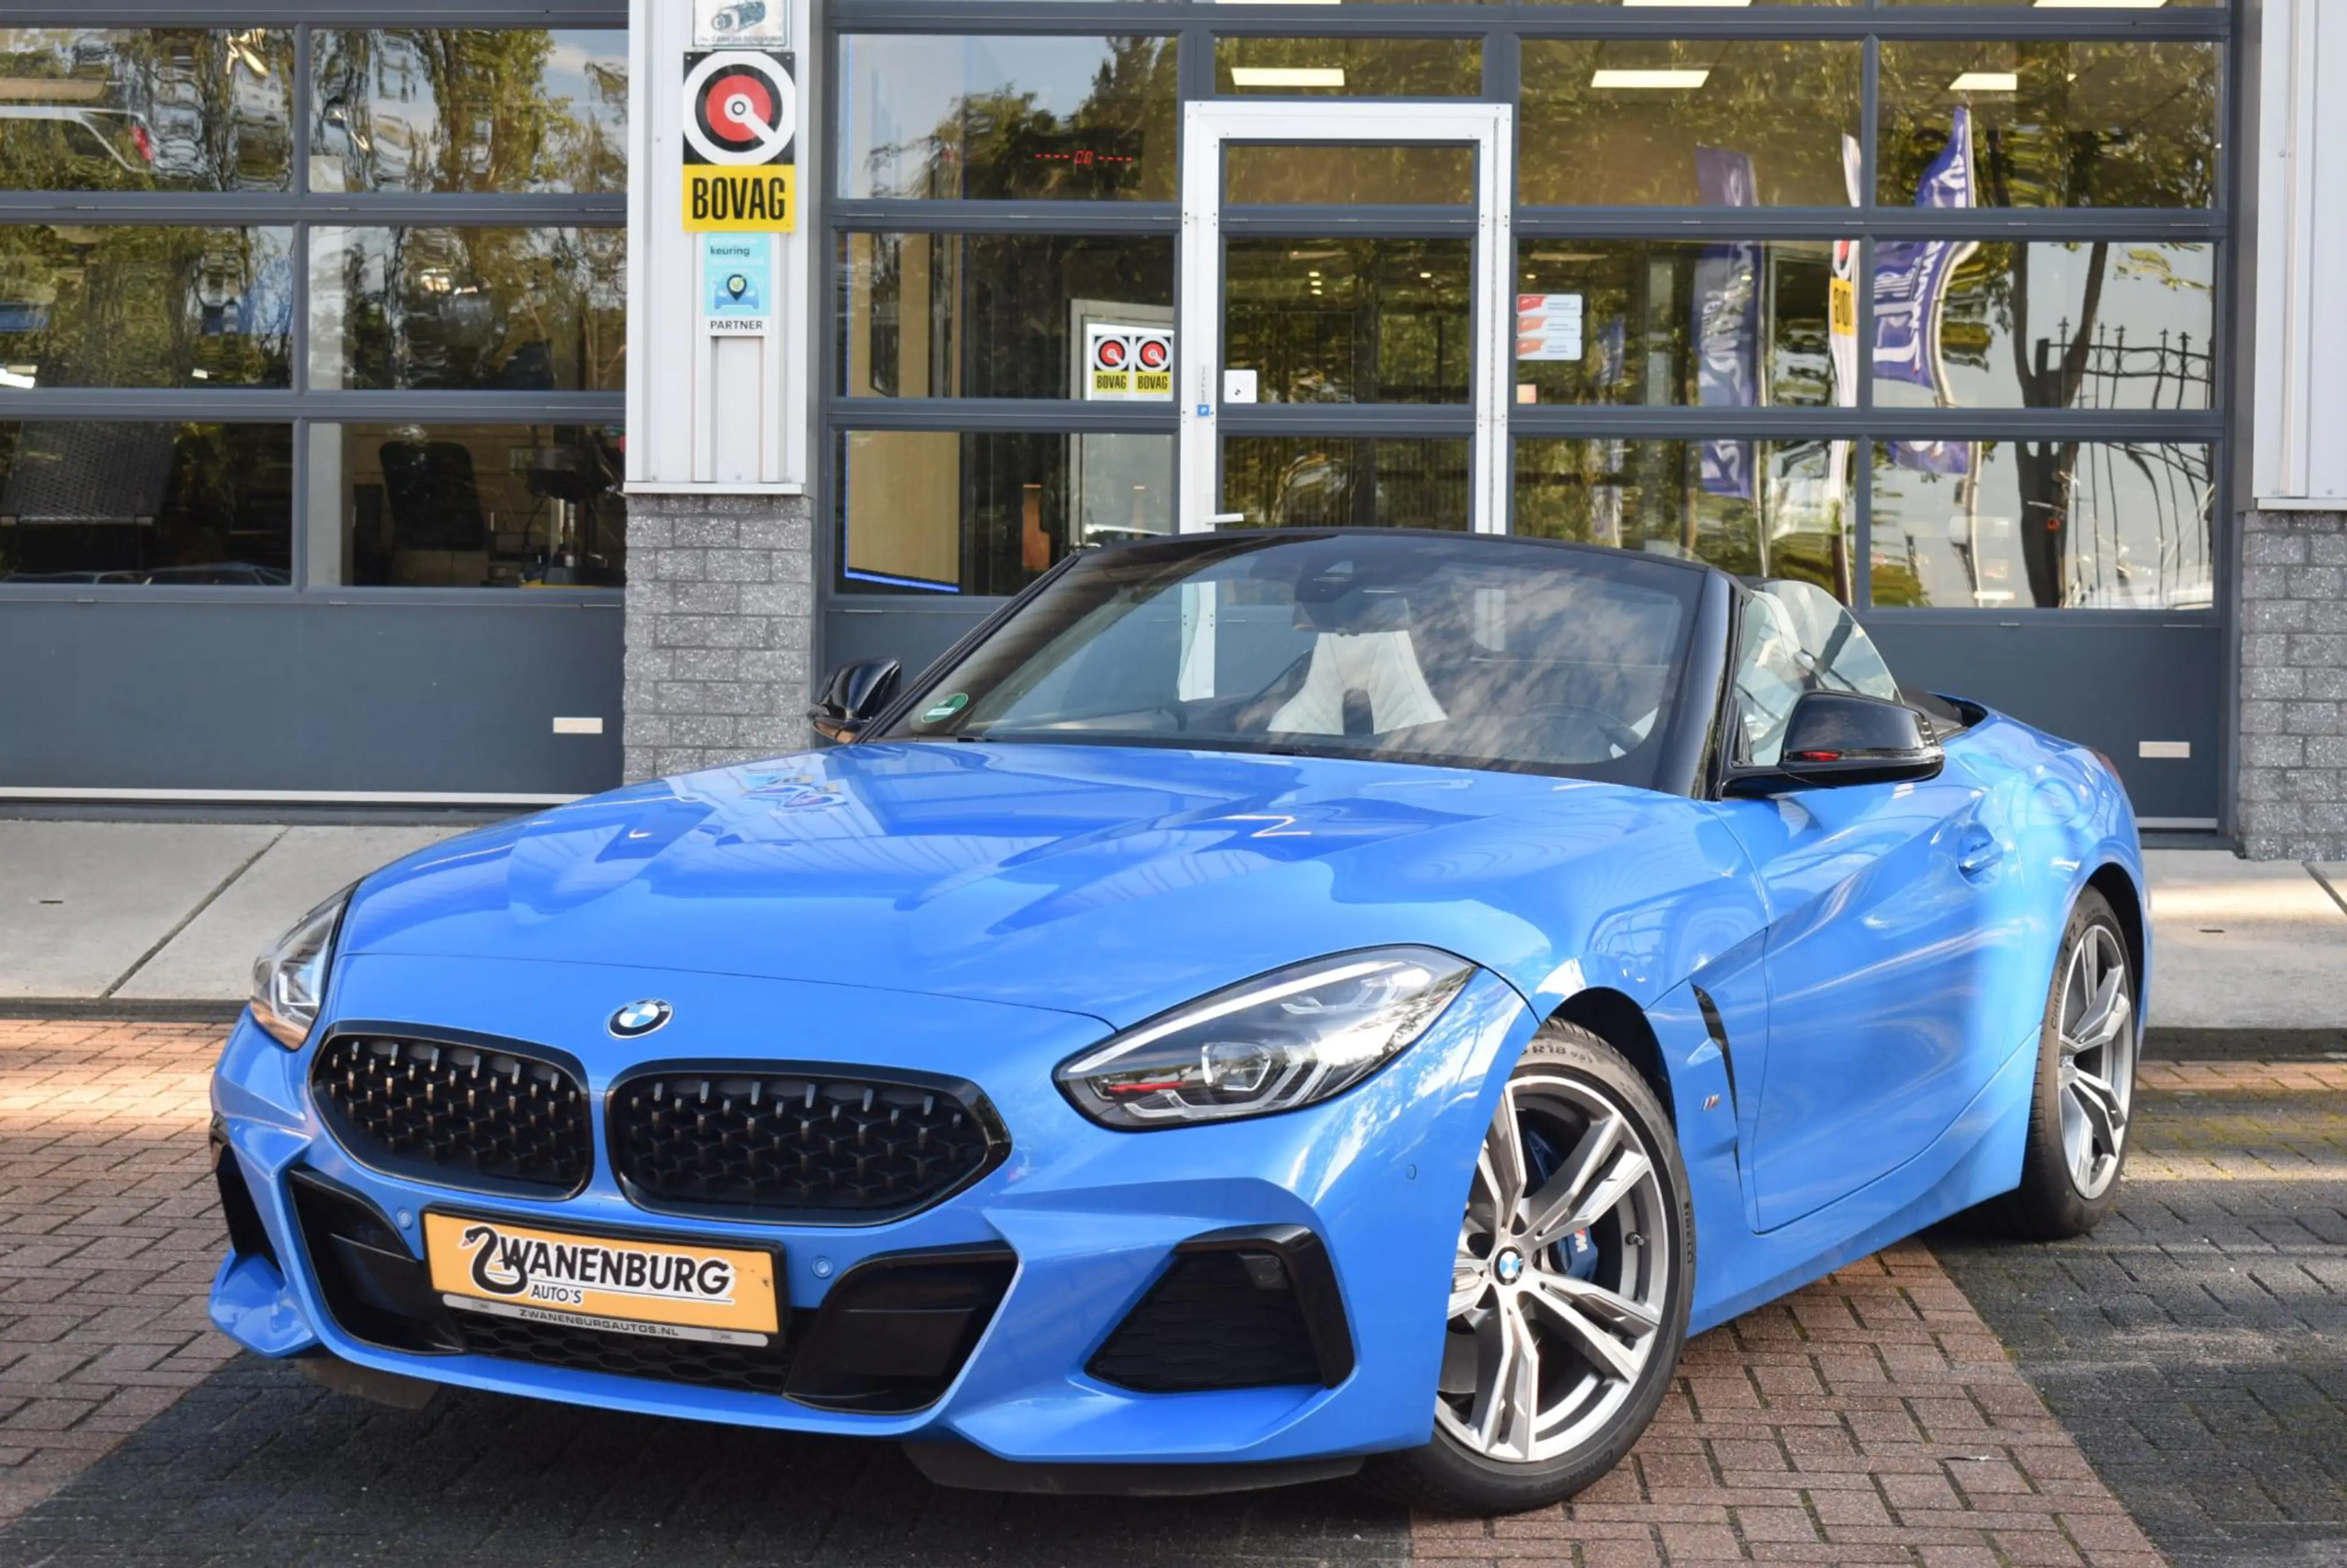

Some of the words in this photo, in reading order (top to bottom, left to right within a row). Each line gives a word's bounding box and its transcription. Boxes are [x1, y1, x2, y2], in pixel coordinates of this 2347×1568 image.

[692, 177, 785, 221] BOVAG
[710, 246, 751, 257] keuring
[710, 320, 763, 330] PARTNER
[1096, 375, 1127, 389] BOVAG
[1137, 375, 1168, 390] BOVAG
[531, 1284, 582, 1304] AUTO'S
[519, 1308, 679, 1336] ZWANENBURGAUTOS.NL
